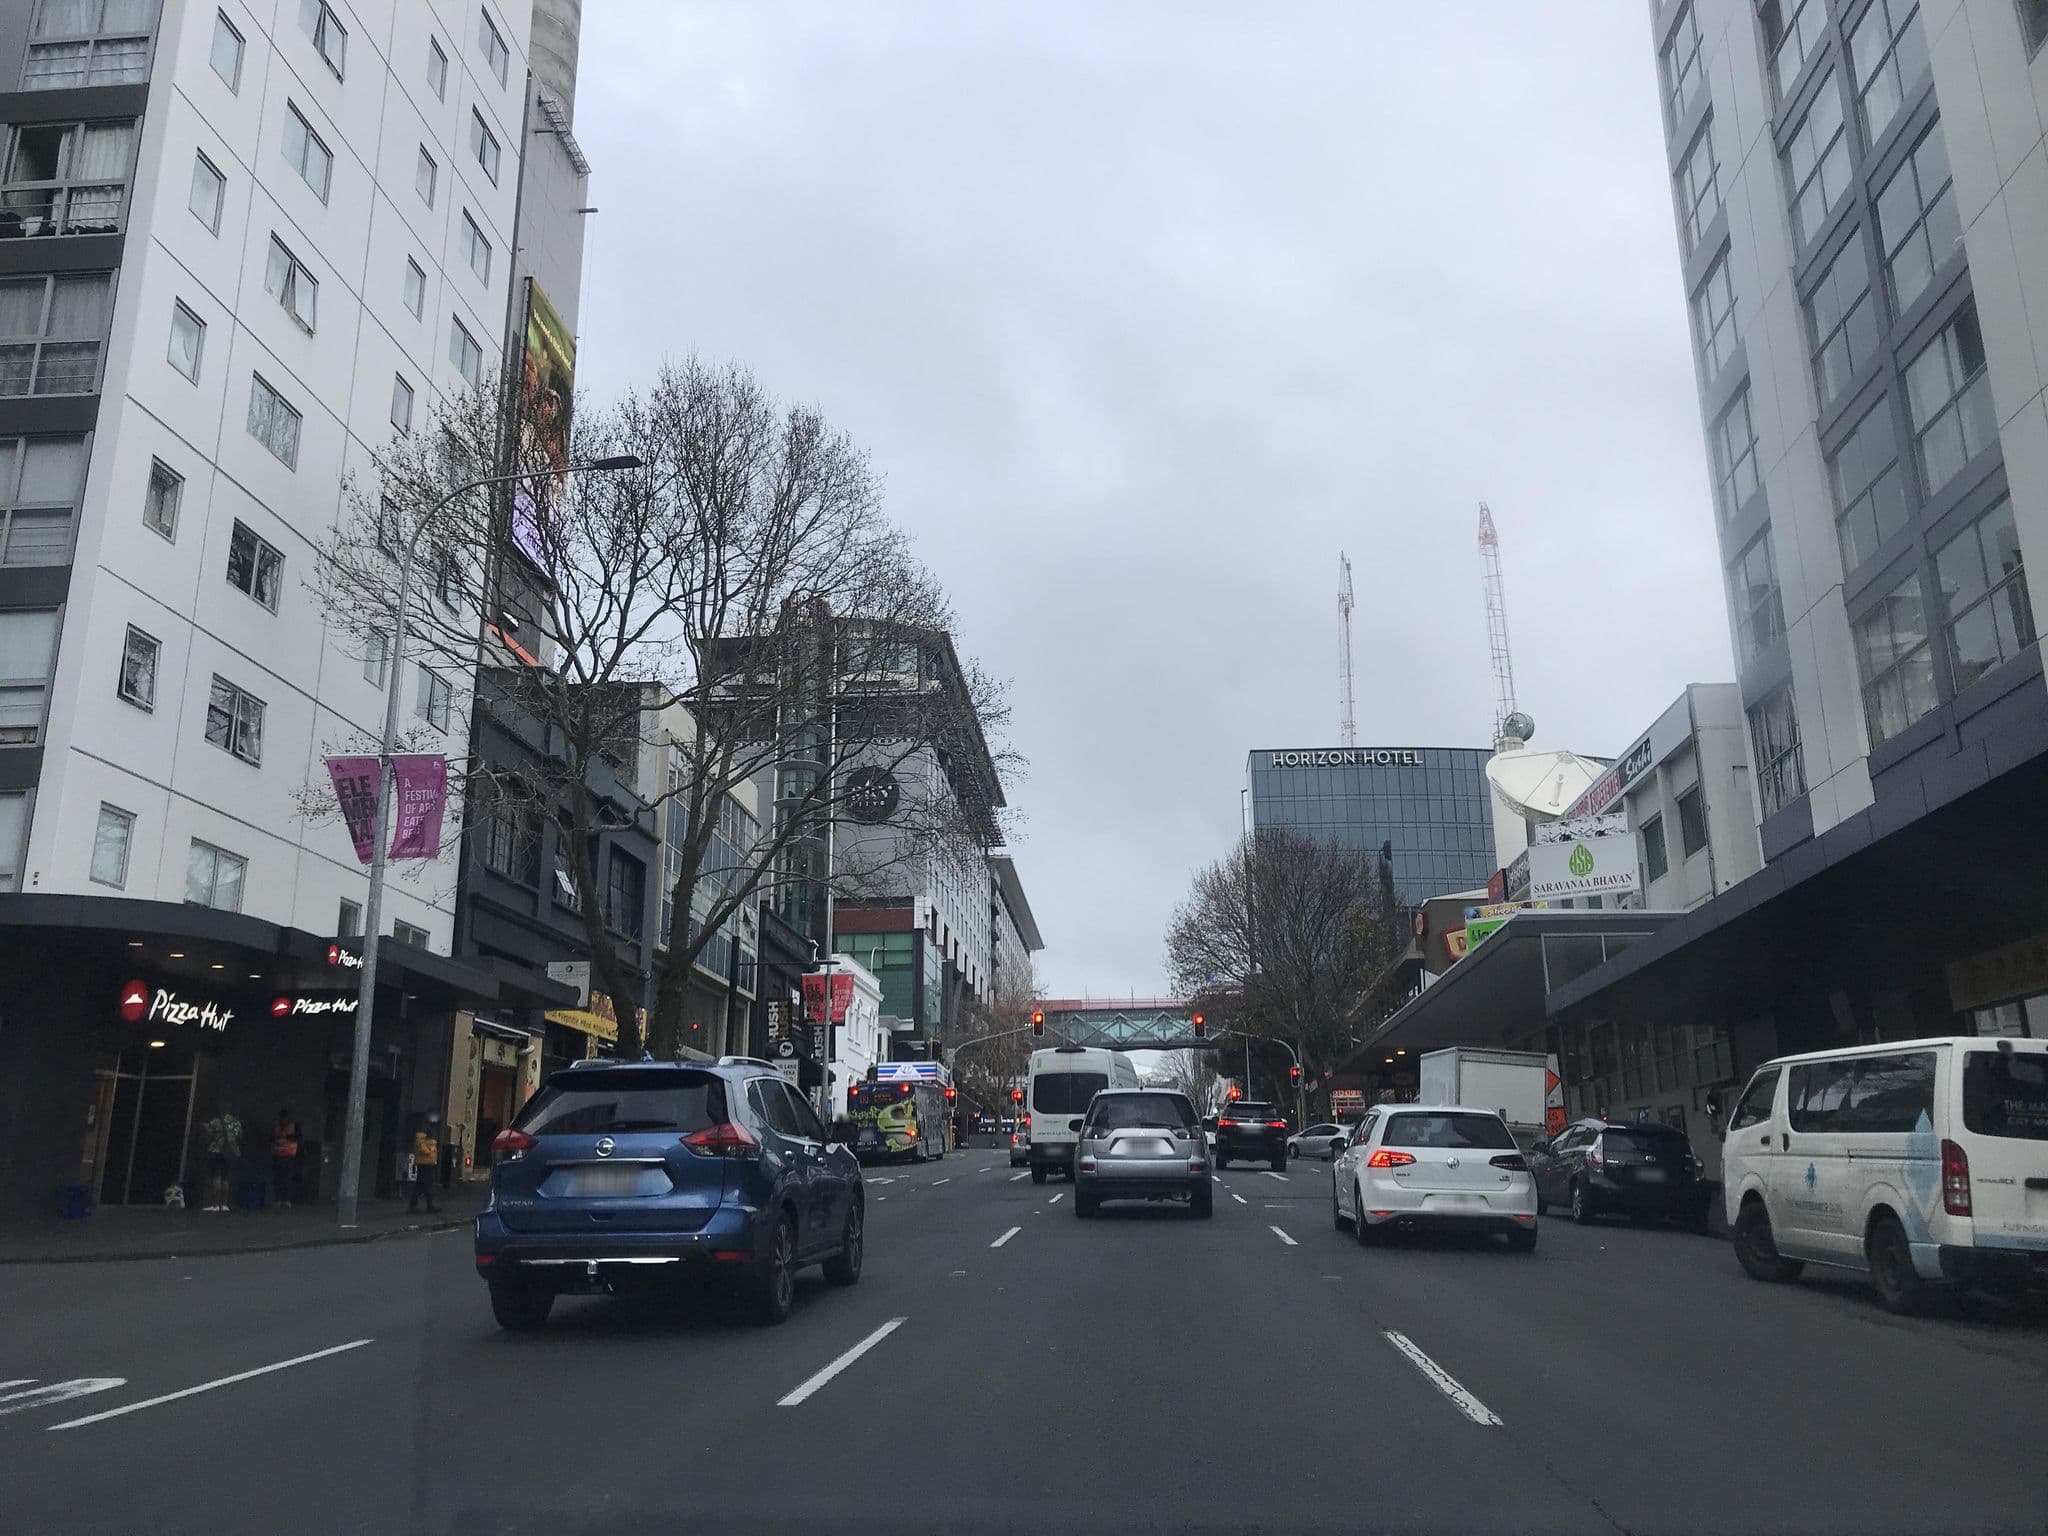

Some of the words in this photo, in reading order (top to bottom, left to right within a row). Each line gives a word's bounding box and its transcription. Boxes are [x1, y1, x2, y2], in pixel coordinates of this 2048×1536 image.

[1272, 751, 1355, 766] HORIZON
[1363, 750, 1423, 764] HOTEL
[1625, 742, 1651, 781] Sushi
[404, 778, 411, 788] A
[405, 804, 416, 814] OF
[1534, 878, 1592, 894] SARAVANAA
[1592, 871, 1633, 887] BHAVAN
[338, 950, 357, 968] Pizza
[148, 988, 199, 1025] Pizza
[200, 1001, 236, 1032] Hut
[292, 999, 331, 1016] Pizza
[332, 999, 359, 1014] Hut
